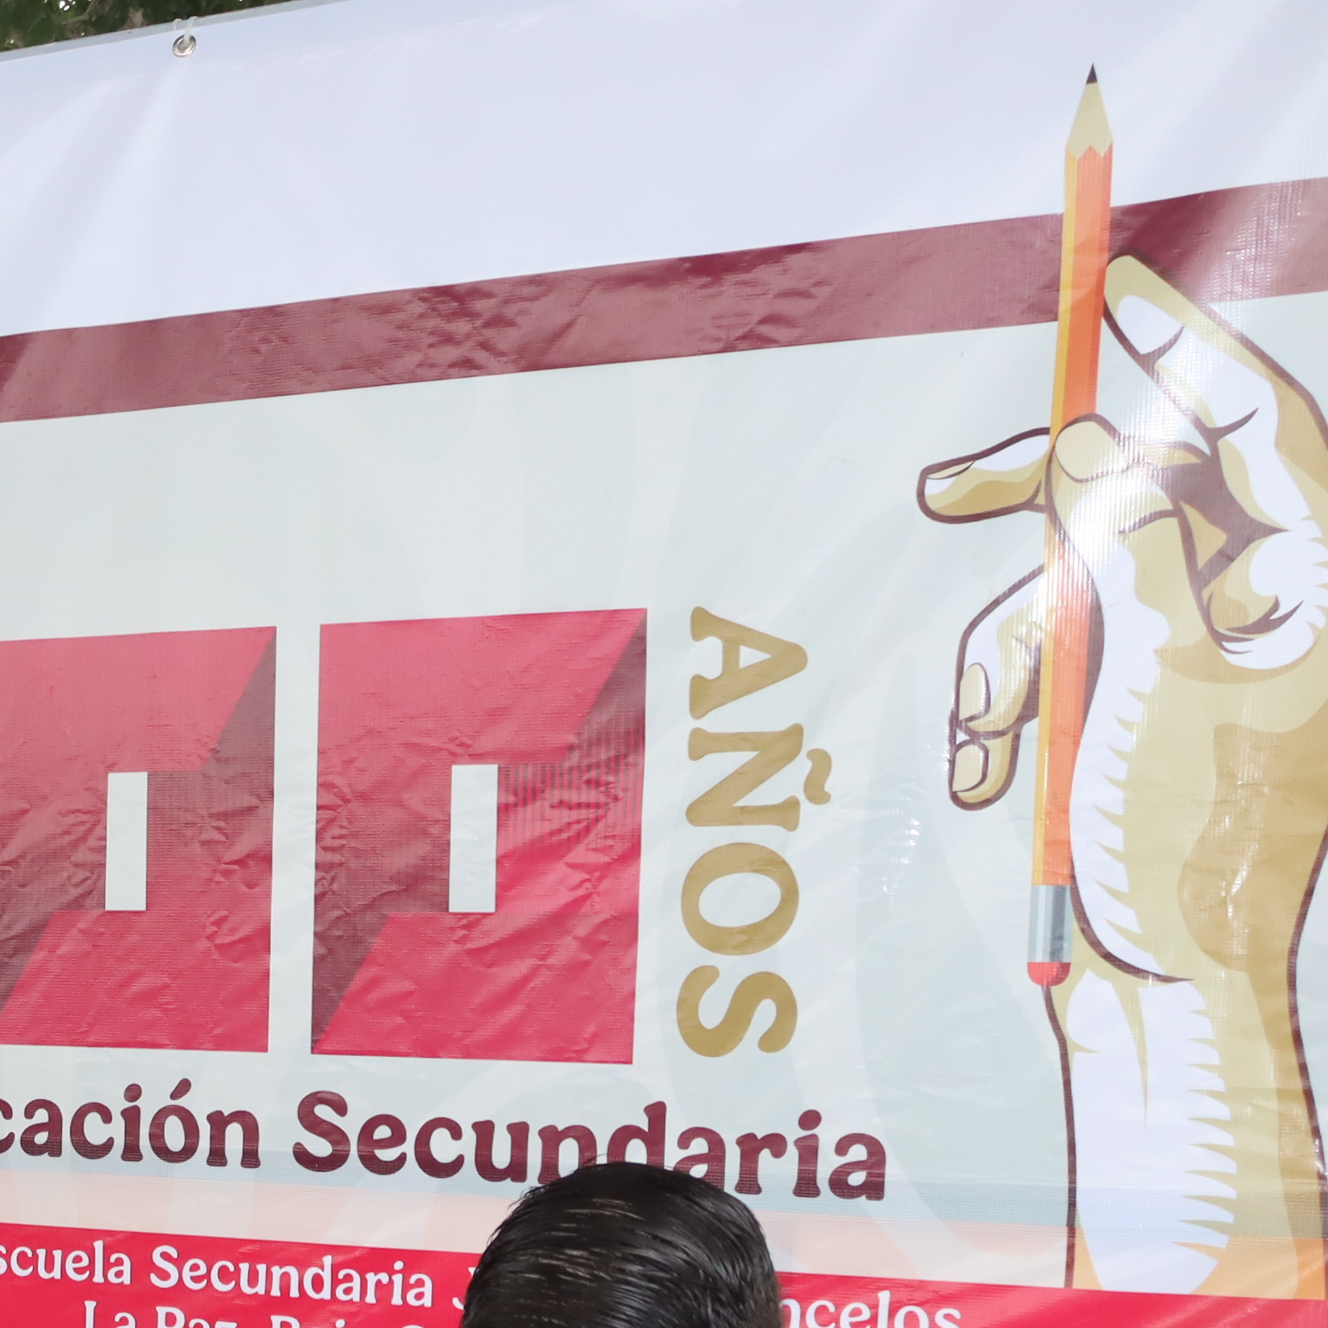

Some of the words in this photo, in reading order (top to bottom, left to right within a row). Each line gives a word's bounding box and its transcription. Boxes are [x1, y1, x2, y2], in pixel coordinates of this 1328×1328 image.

[675, 606, 833, 1060] AÑOS
[292, 1089, 887, 1201] Secundaria
[150, 1244, 433, 1308] Secundaria
